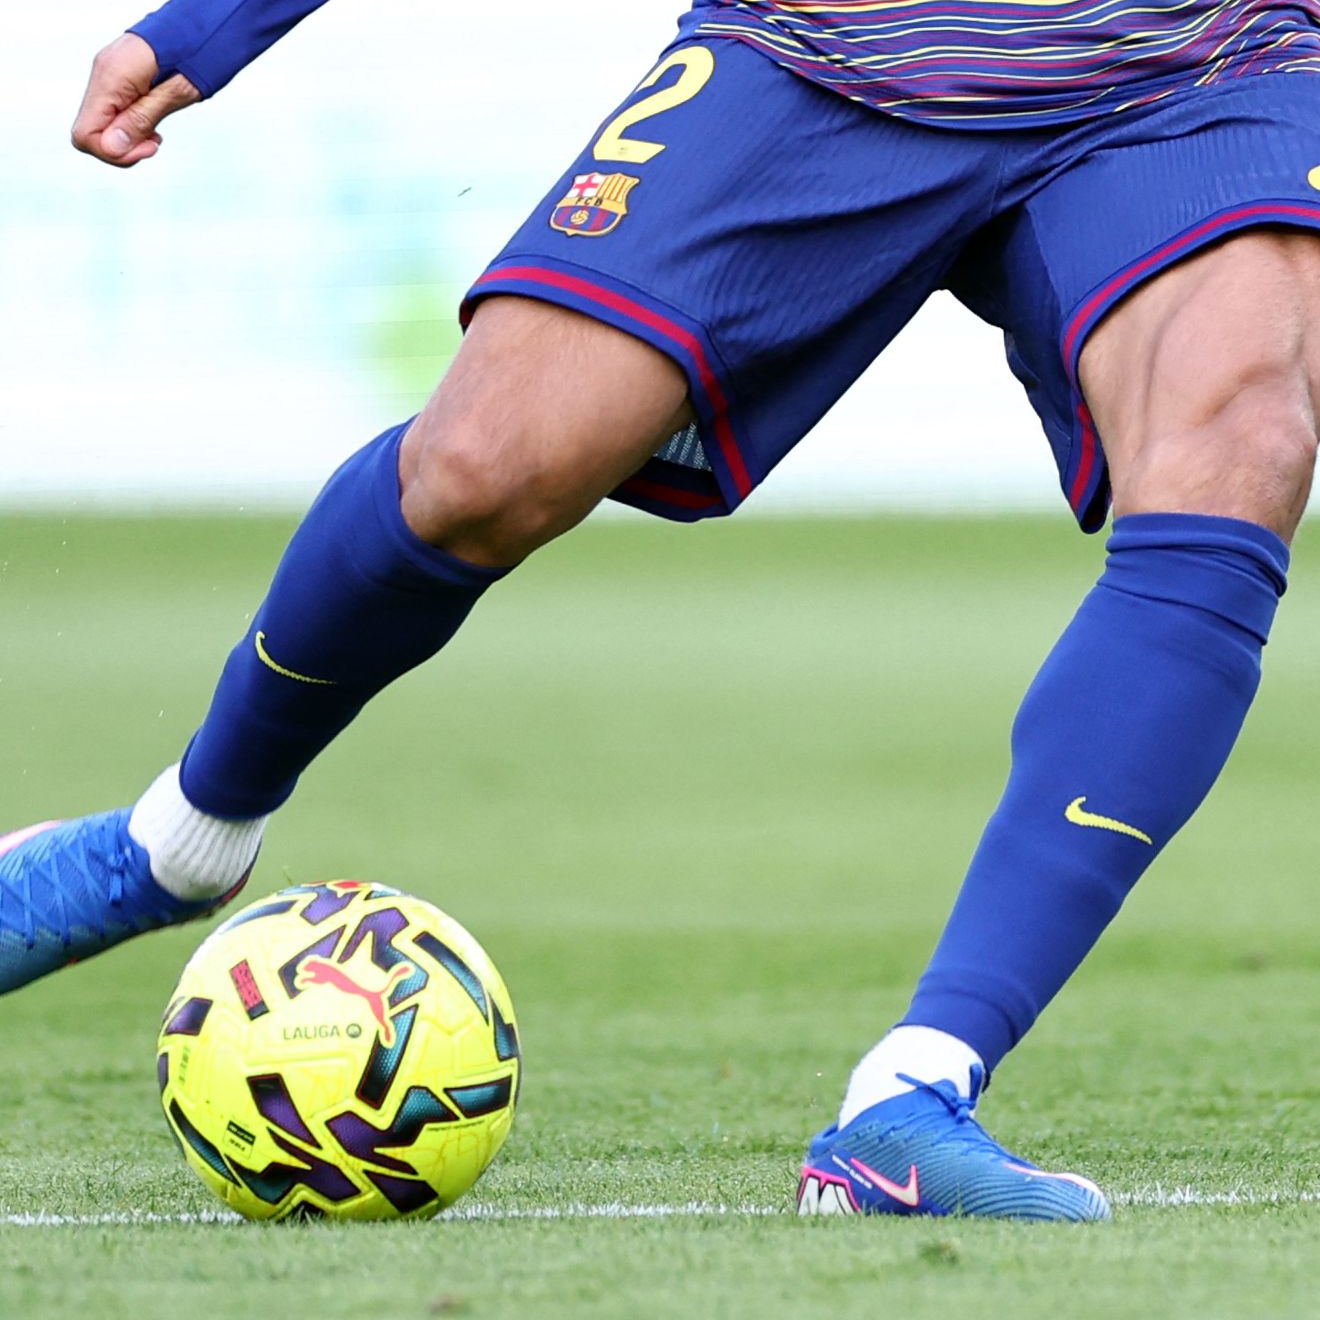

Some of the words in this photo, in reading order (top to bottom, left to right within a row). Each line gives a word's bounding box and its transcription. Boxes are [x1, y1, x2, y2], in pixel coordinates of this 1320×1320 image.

[593, 45, 714, 164] 2
[575, 196, 603, 206] FCB
[283, 1024, 340, 1040] LALIGA
